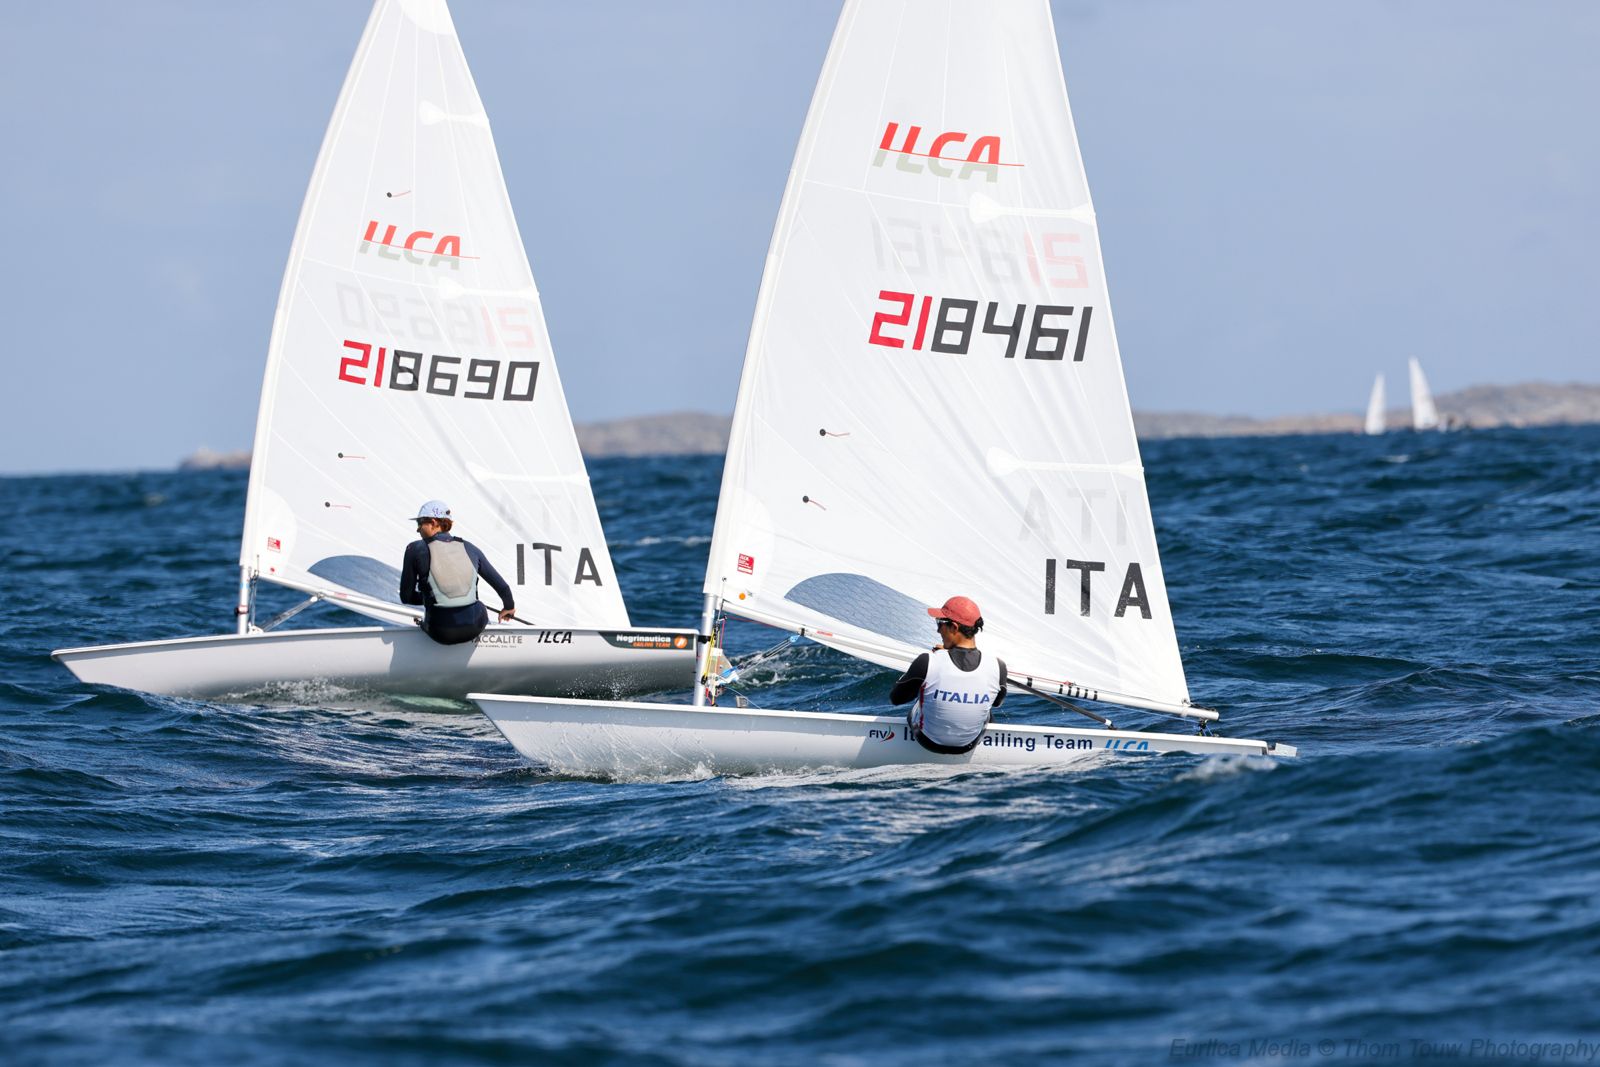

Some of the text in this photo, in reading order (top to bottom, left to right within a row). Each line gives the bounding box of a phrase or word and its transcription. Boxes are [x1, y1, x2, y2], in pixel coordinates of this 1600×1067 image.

[872, 122, 1001, 183] ILCA
[358, 220, 461, 271] ILCA
[868, 290, 1093, 362] 218461
[338, 339, 540, 402] 218690
[516, 542, 603, 587] ITA
[1044, 558, 1152, 620] ITA
[472, 634, 523, 644] ACCALITE
[537, 630, 573, 644] ILCA
[616, 634, 671, 644] Negrinautica
[933, 689, 991, 705] ITALIA
[869, 729, 888, 739] FIV
[978, 732, 1093, 752] ailing Team
